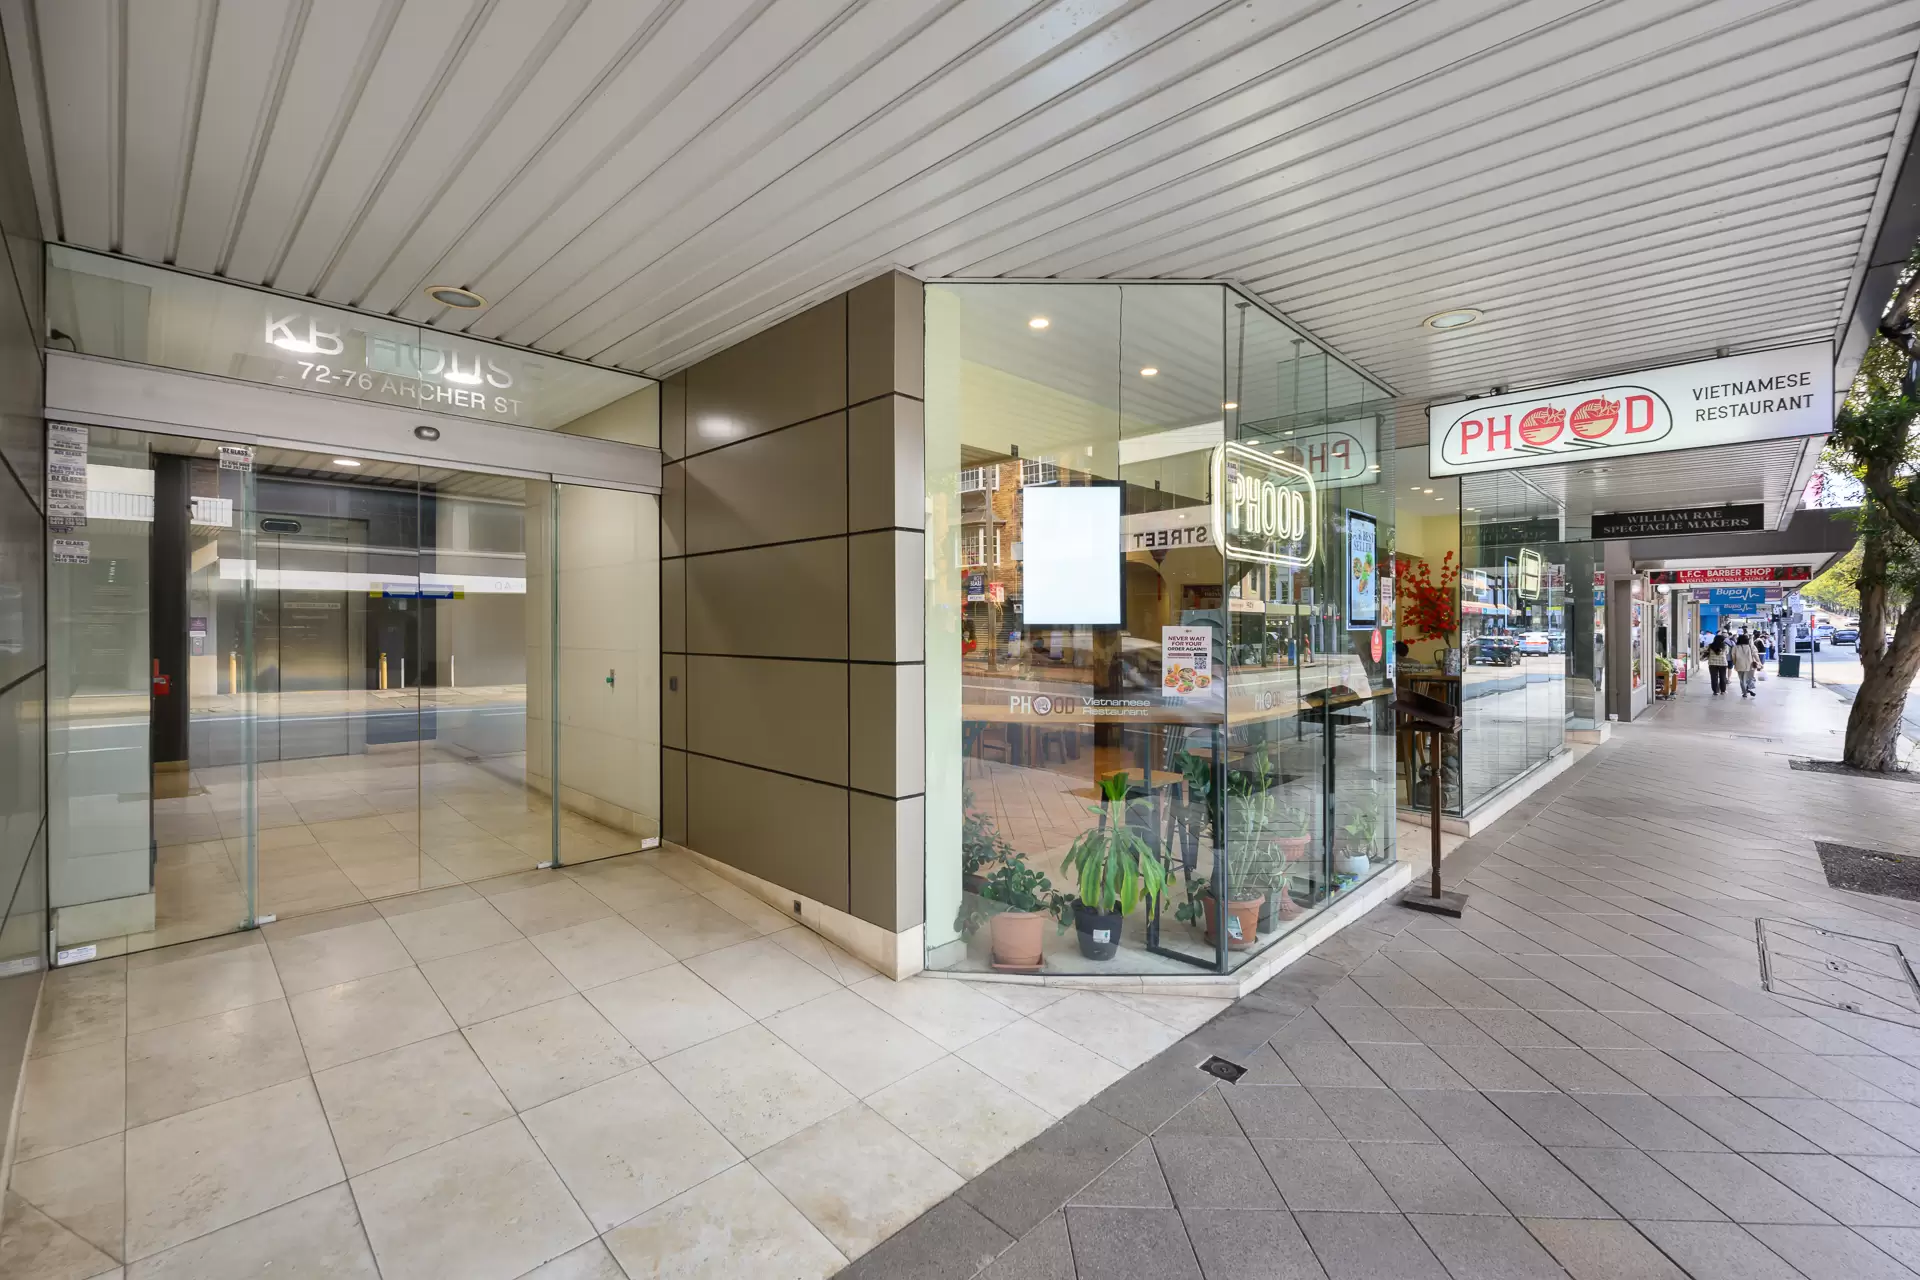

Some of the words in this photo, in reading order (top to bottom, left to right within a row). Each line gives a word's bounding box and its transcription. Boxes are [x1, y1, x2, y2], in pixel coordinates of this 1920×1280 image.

[265, 312, 344, 356] KB
[298, 360, 373, 391] 72-76
[380, 376, 486, 410] ARCHER
[494, 396, 523, 417] ST
[1692, 371, 1811, 401] VIETNAMESE
[1695, 393, 1814, 422] RESTAURANT
[1460, 394, 1654, 456] PHOOD
[1231, 472, 1305, 541] PHOOD
[1627, 512, 1689, 524] WILLIAM
[1693, 510, 1723, 520] RAE
[1603, 522, 1684, 534] SPECTACLE
[1687, 517, 1750, 530] MAKERS
[1679, 569, 1704, 579] L.F.C.
[1706, 568, 1742, 577] BARBER
[1744, 567, 1772, 576] SHOP
[1715, 588, 1743, 597] Bupa
[1009, 694, 1075, 716] PHOOD
[1082, 696, 1151, 707] Vietnamese
[1082, 706, 1149, 716] Restaurant
